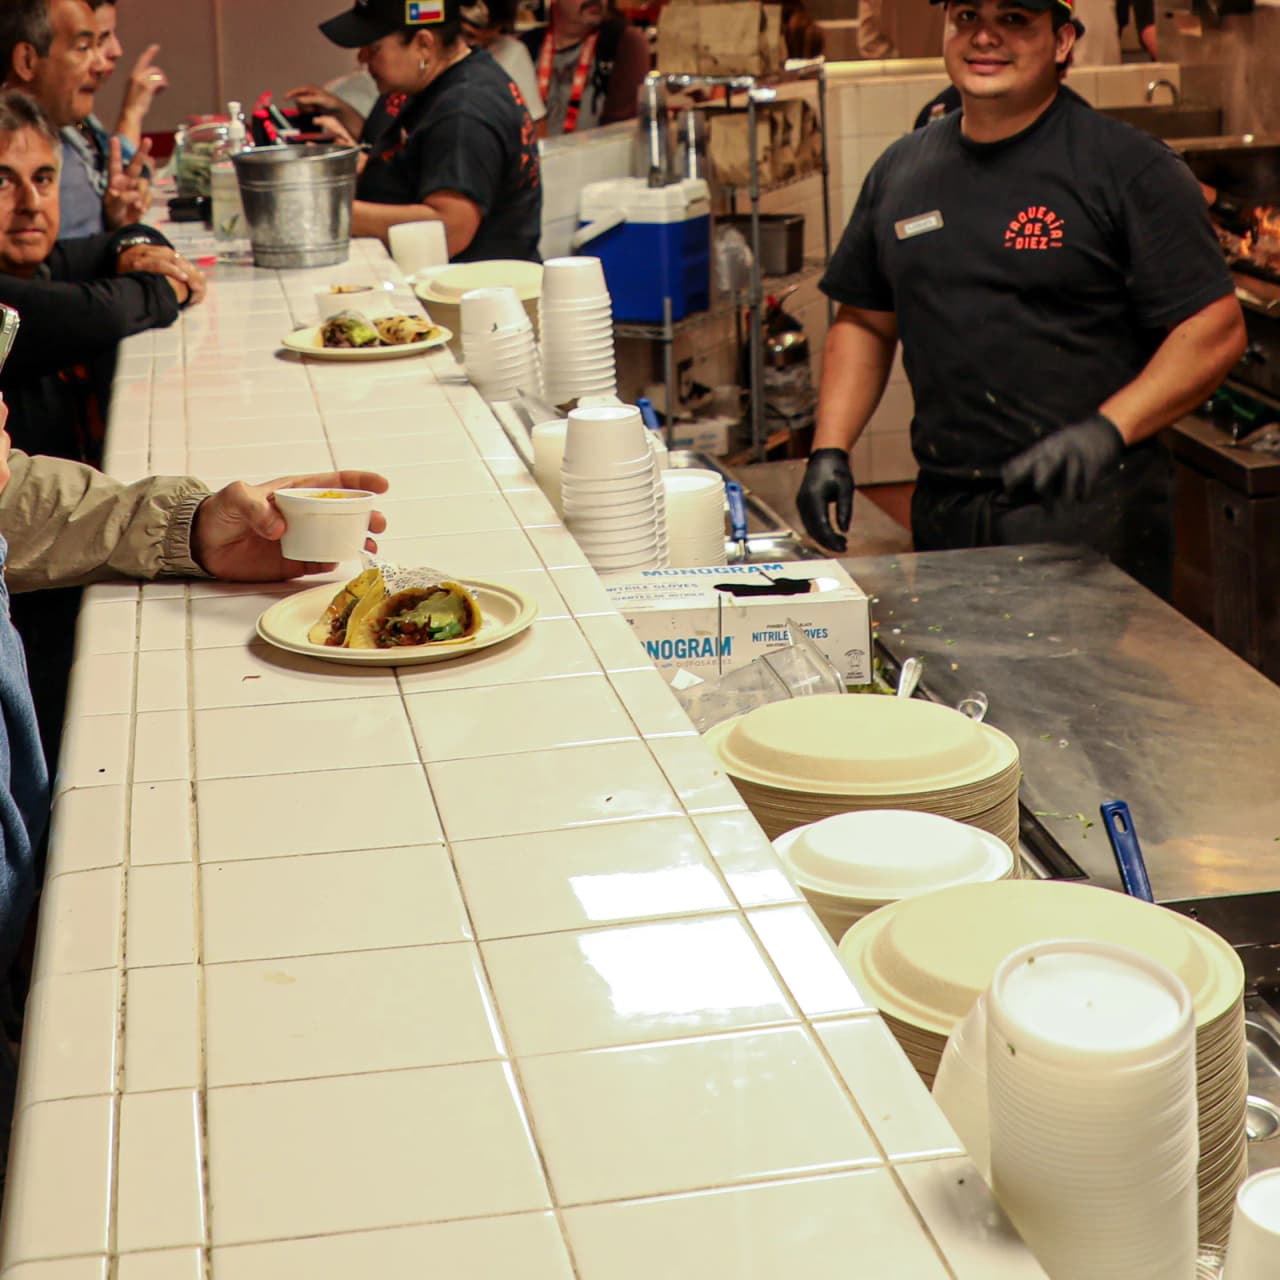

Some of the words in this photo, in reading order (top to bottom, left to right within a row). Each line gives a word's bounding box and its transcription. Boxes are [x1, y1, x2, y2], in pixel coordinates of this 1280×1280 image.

[1024, 223, 1042, 235] DE
[1015, 236, 1048, 250] DIEZ
[642, 563, 785, 577] MONOGRAM
[752, 630, 789, 643] NITRILE
[640, 636, 732, 660] NOGRAM
